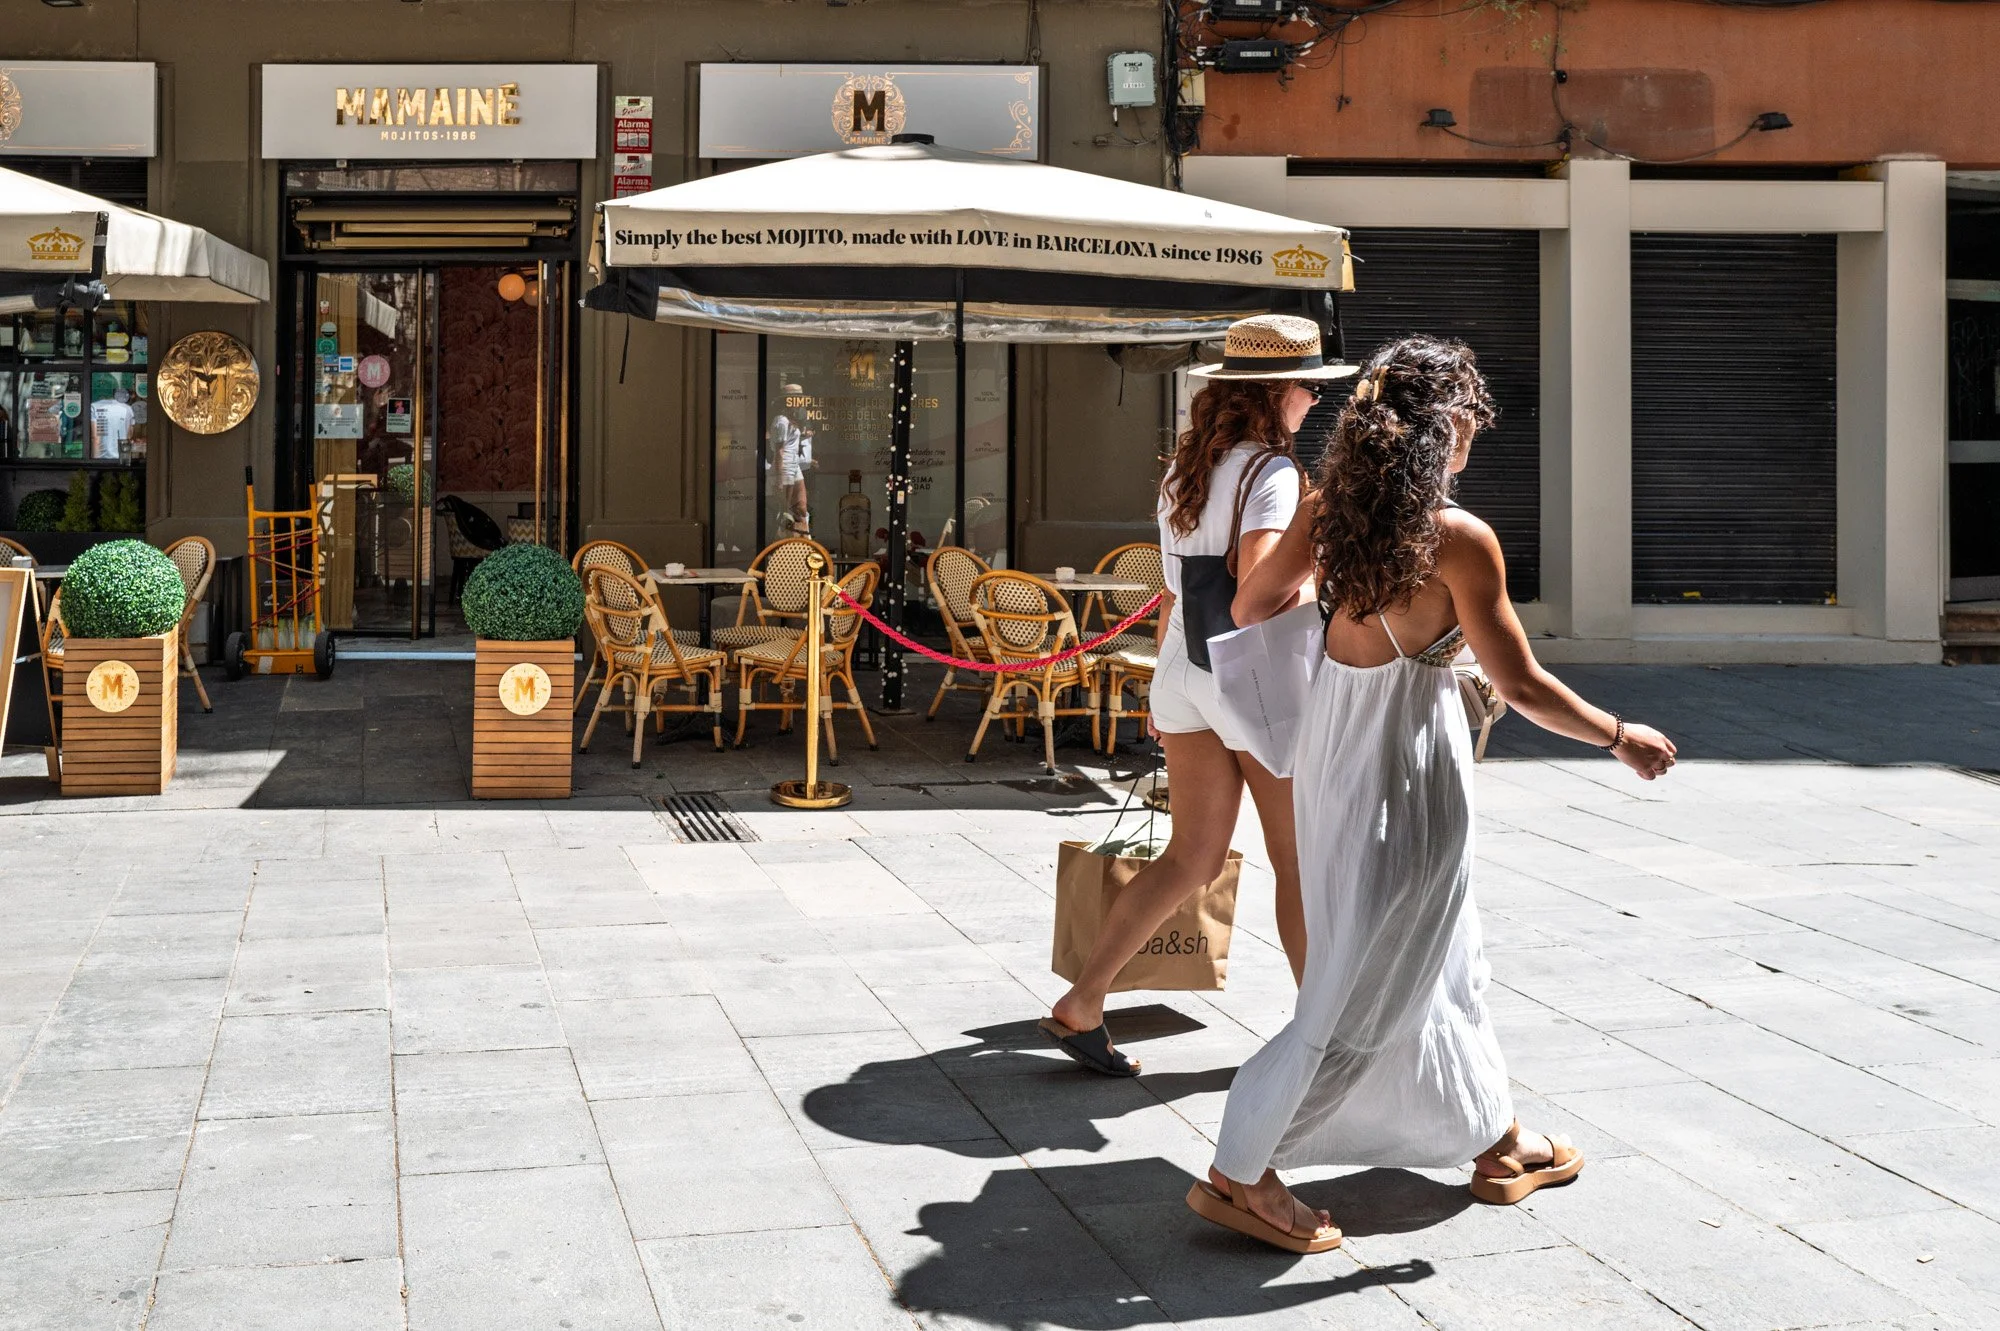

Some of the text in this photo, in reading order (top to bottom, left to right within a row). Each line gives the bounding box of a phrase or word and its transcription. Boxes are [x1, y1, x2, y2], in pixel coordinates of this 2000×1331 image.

[336, 82, 520, 125] MAMAINÉ
[853, 90, 886, 132] M
[617, 120, 650, 129] Alarma
[617, 177, 649, 186] Alarma
[615, 228, 1263, 266] Simply the best MOJITO, made with LOVE in BARCELONA since 1986
[102, 674, 123, 700] M
[514, 676, 535, 702] M
